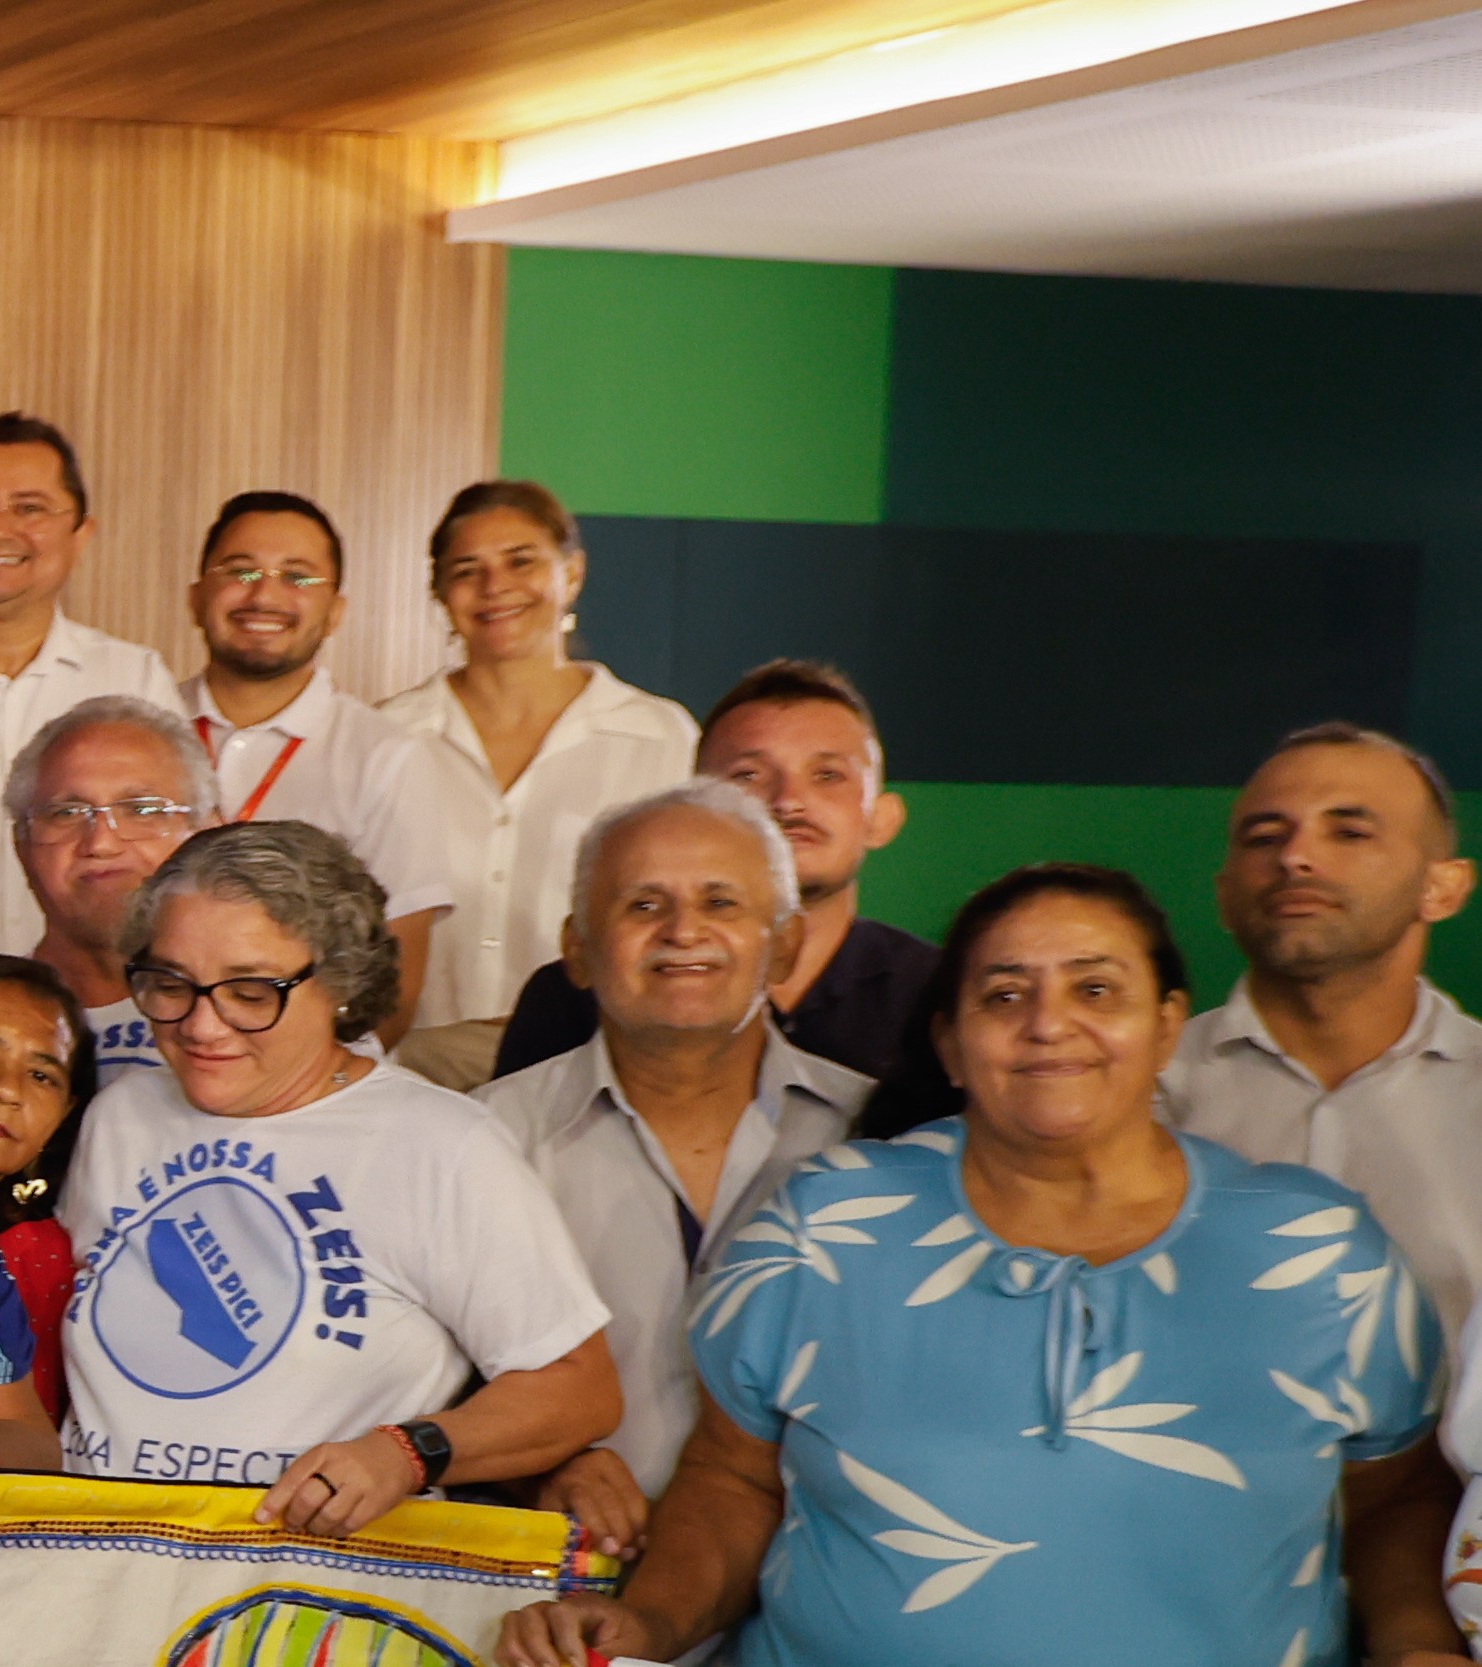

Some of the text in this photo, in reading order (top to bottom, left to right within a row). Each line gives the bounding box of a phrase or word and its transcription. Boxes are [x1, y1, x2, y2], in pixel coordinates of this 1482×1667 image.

[163, 1139, 275, 1186] NOSSA
[285, 1175, 367, 1350] ZEIS!
[182, 1211, 264, 1330] ZEIS PICI
